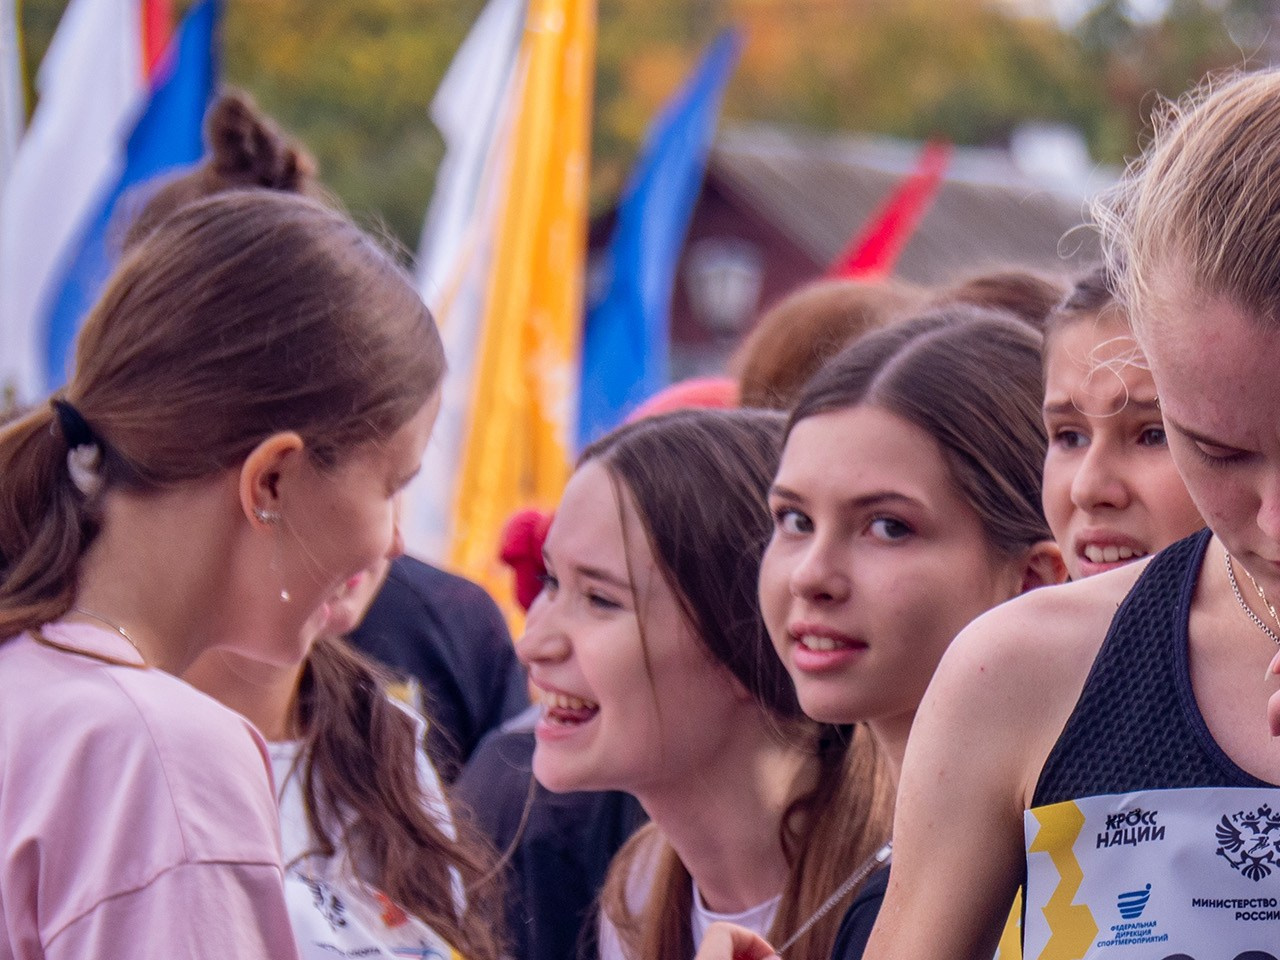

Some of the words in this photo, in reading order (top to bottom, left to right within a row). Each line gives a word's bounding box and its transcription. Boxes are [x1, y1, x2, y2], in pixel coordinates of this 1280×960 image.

[1105, 809, 1158, 830] КРОСС
[1096, 825, 1165, 849] НАЦИИ
[1191, 897, 1278, 909] МИНИСТЕРСТВО
[1235, 911, 1280, 921] РОССИИ
[1110, 920, 1157, 932] ФЕДЕРАЛЬНАЯ
[1096, 933, 1169, 948] СПОРТМЕРОПРИЯТИЙ
[1114, 929, 1152, 940] ДИРЕКЦИЯ
